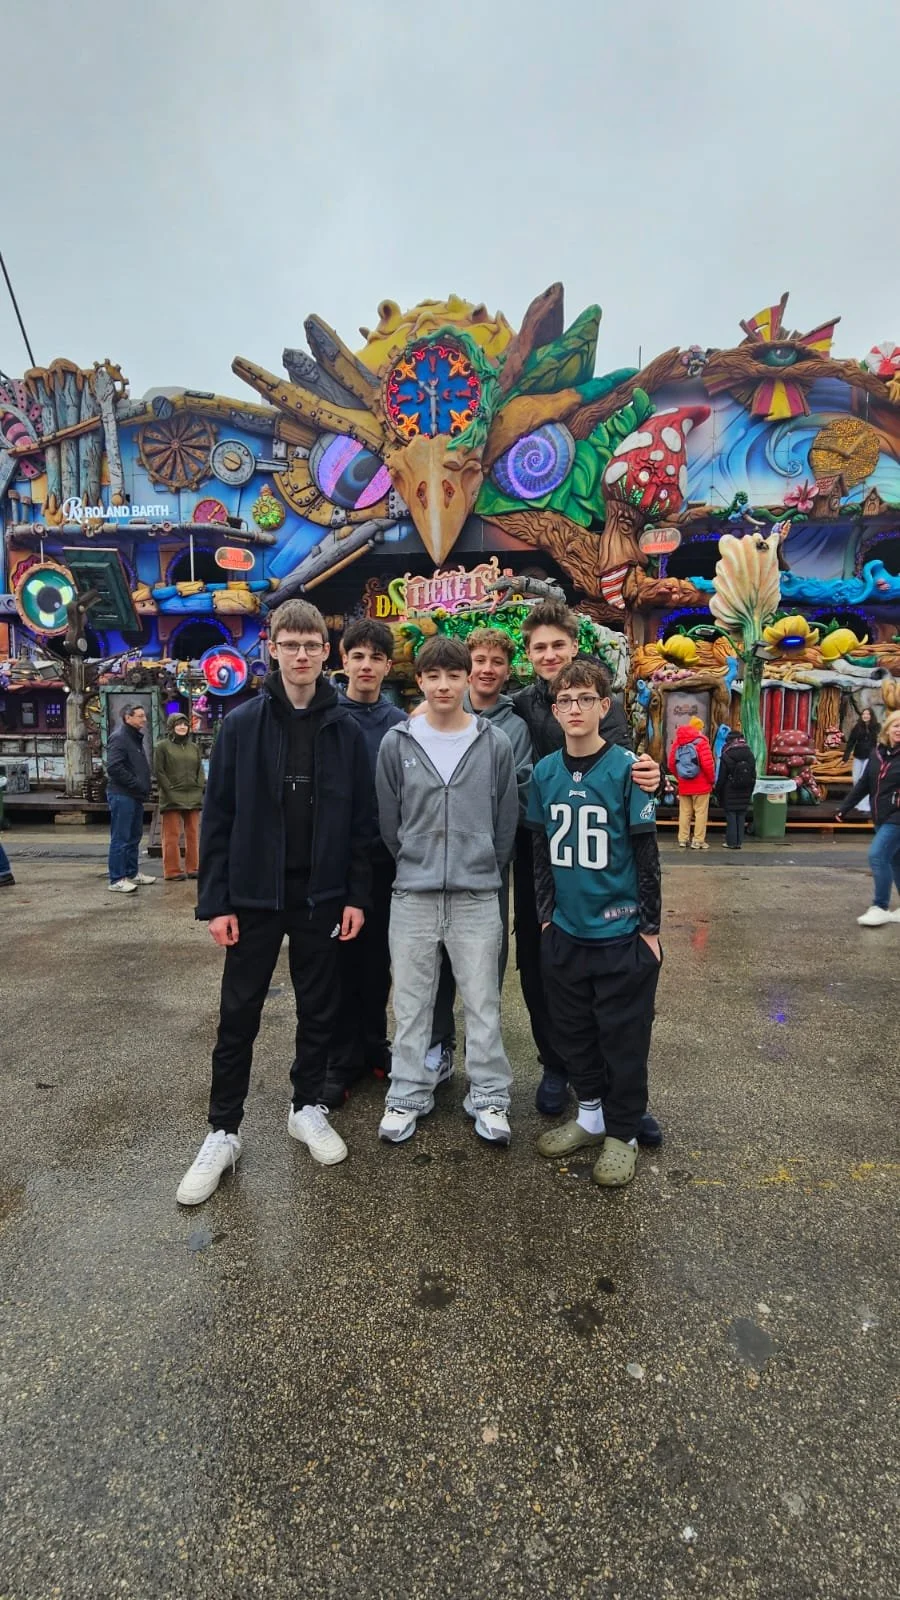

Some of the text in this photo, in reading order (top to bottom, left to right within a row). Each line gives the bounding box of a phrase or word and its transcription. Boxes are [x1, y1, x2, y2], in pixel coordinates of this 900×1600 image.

[85, 506, 129, 518] ROLAND
[131, 505, 168, 517] BARTH
[411, 568, 499, 606] TICKETS
[549, 803, 609, 870] 26
